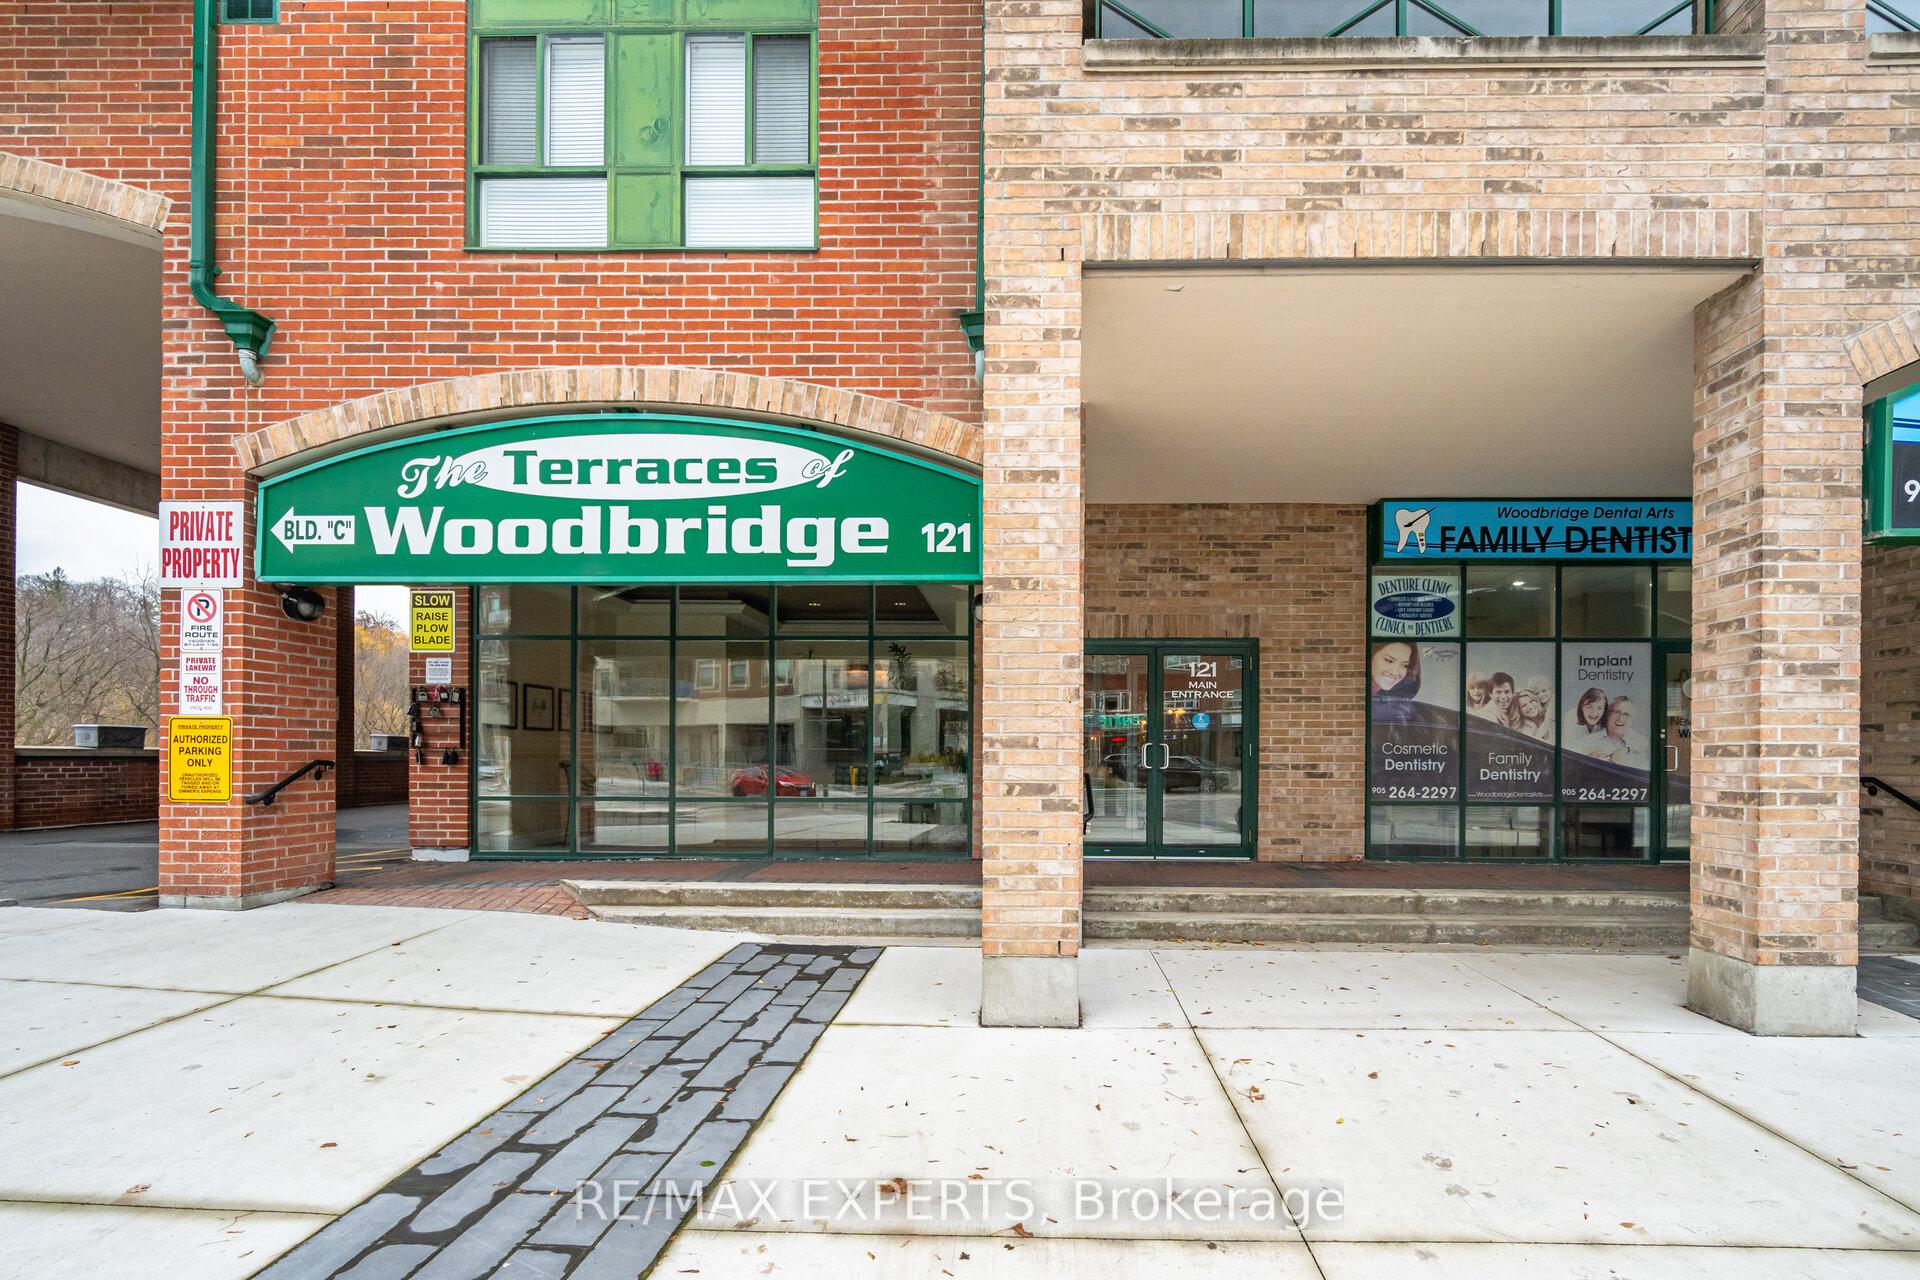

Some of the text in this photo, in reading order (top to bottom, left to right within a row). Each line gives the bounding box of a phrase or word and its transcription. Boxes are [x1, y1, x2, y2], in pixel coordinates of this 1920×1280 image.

[397, 449, 855, 499] The Terraces of
[1497, 506, 1675, 520] Woodbridge Dental Arts
[169, 511, 234, 541] PRIVATE
[284, 520, 352, 541] BLD. "C"
[363, 505, 890, 567] Woodbridge
[921, 522, 971, 553] 121
[1440, 526, 1692, 554] FAMILY DENTIST
[161, 547, 240, 578] PROPERTY
[1377, 577, 1453, 595] DENTURE CLINIC
[414, 595, 451, 607] SLOW
[416, 612, 448, 621] RAISE
[416, 624, 449, 633] PLOW
[1376, 617, 1406, 635] CLINICA
[1415, 617, 1455, 636] DENTIERE
[414, 636, 450, 645] BLADE
[1579, 654, 1633, 669] Implant
[1189, 662, 1217, 678] 121
[1578, 669, 1634, 683] Dentistry
[184, 686, 218, 694] THROUGH
[1188, 681, 1217, 689] MAIN
[1171, 691, 1234, 699] ENTRANCE
[173, 735, 228, 744] AUTHORIZED
[178, 747, 222, 755] PARKING
[1382, 743, 1448, 755] Cosmetic
[187, 758, 213, 767] ONLY
[1384, 759, 1446, 774] Dentistry
[1488, 752, 1533, 767] Family
[1479, 768, 1541, 783] Dentistry
[1371, 786, 1457, 799] 905 264-2297
[1561, 788, 1648, 800] 905 264-2297
